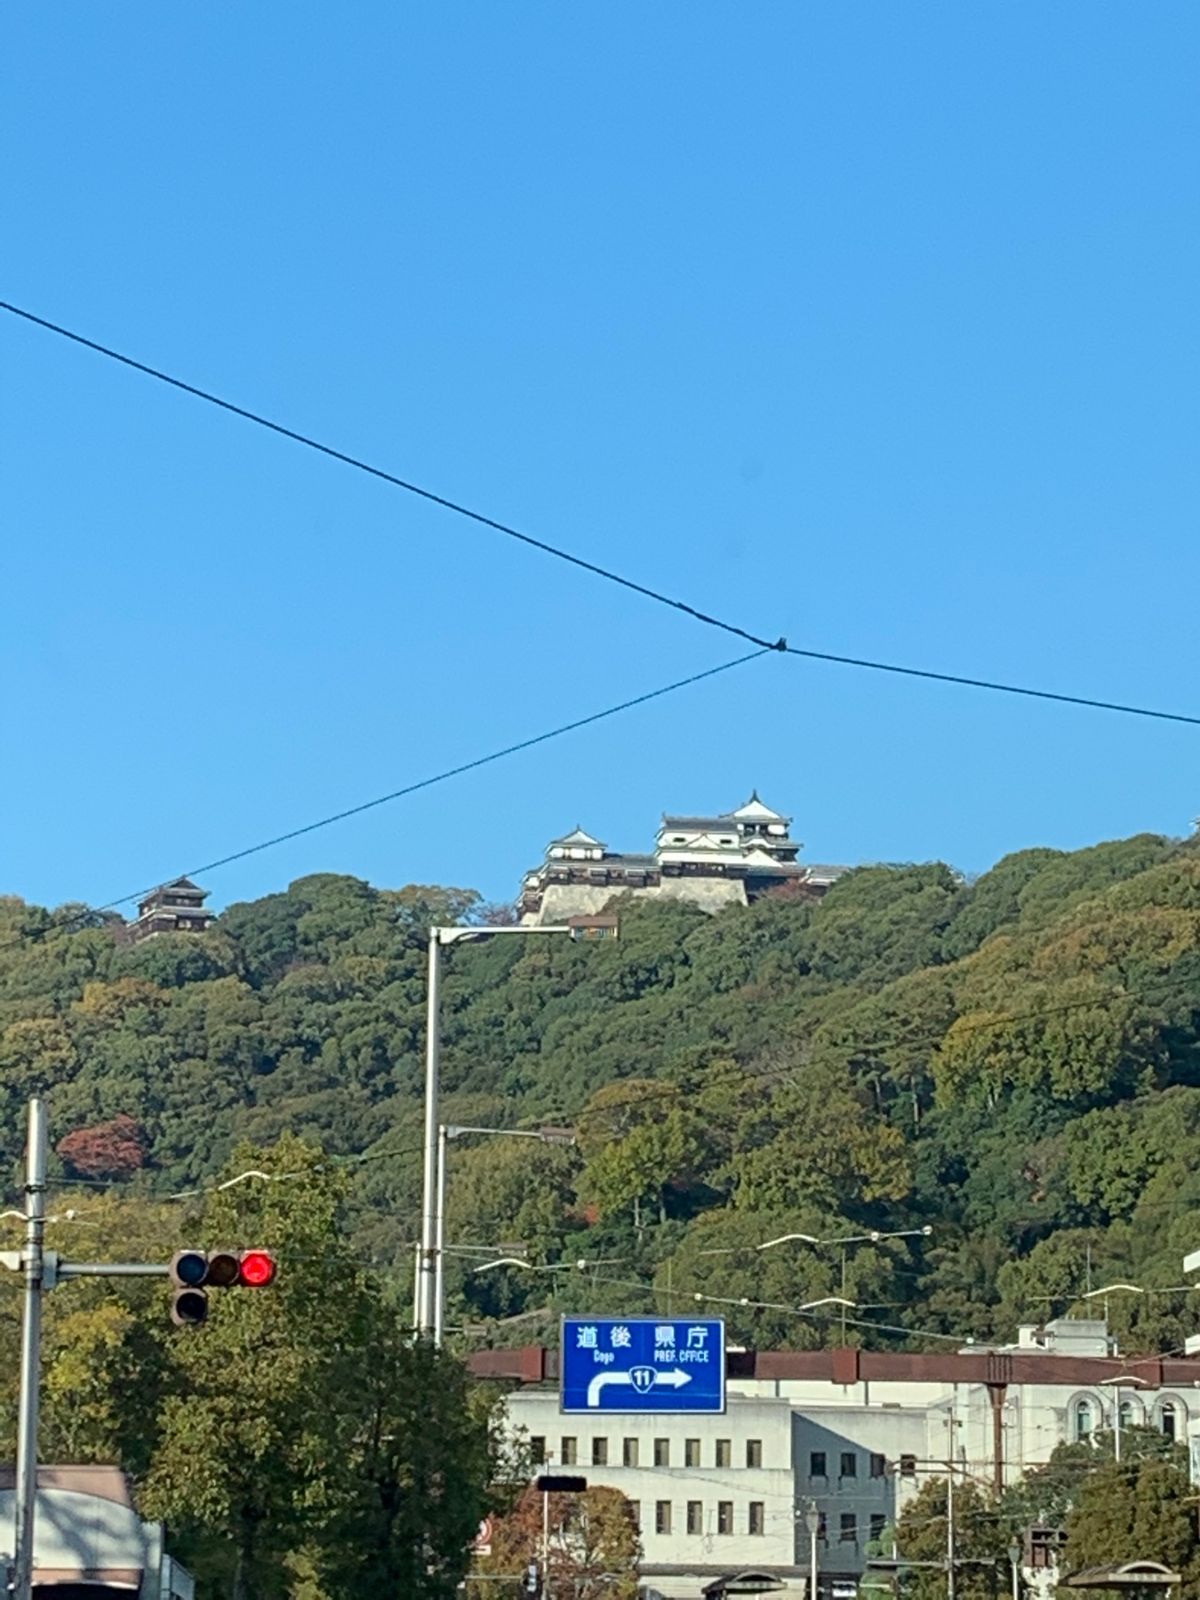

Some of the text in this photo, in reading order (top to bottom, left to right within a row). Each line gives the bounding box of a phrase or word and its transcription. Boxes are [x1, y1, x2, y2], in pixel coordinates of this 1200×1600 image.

[576, 1326, 631, 1348] 道後
[655, 1326, 708, 1348] 県庁
[679, 1350, 709, 1362] OFFICE
[634, 1370, 650, 1386] 11
